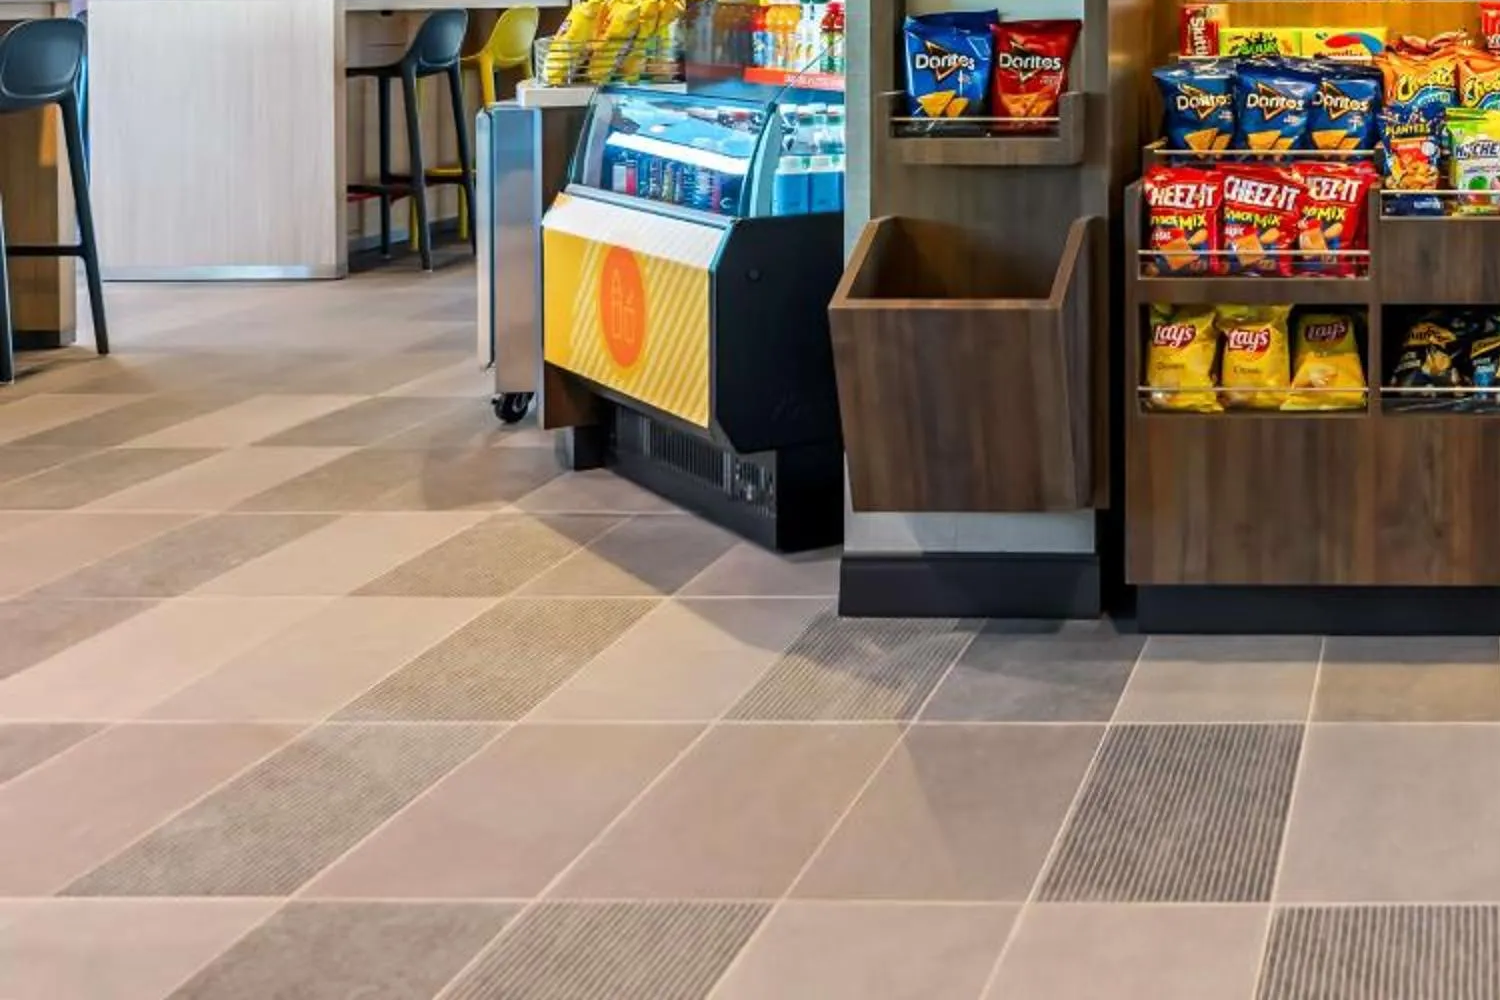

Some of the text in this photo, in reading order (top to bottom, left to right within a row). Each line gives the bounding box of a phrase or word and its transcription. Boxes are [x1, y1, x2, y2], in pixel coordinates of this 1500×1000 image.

[915, 53, 975, 71] Doritos
[1000, 53, 1062, 70] Doritos
[1397, 68, 1453, 101] Cheeto
[1247, 93, 1304, 111] Doritos
[1312, 91, 1370, 112] Doritos
[1153, 324, 1195, 348] Lay's
[1229, 329, 1269, 352] Lay's
